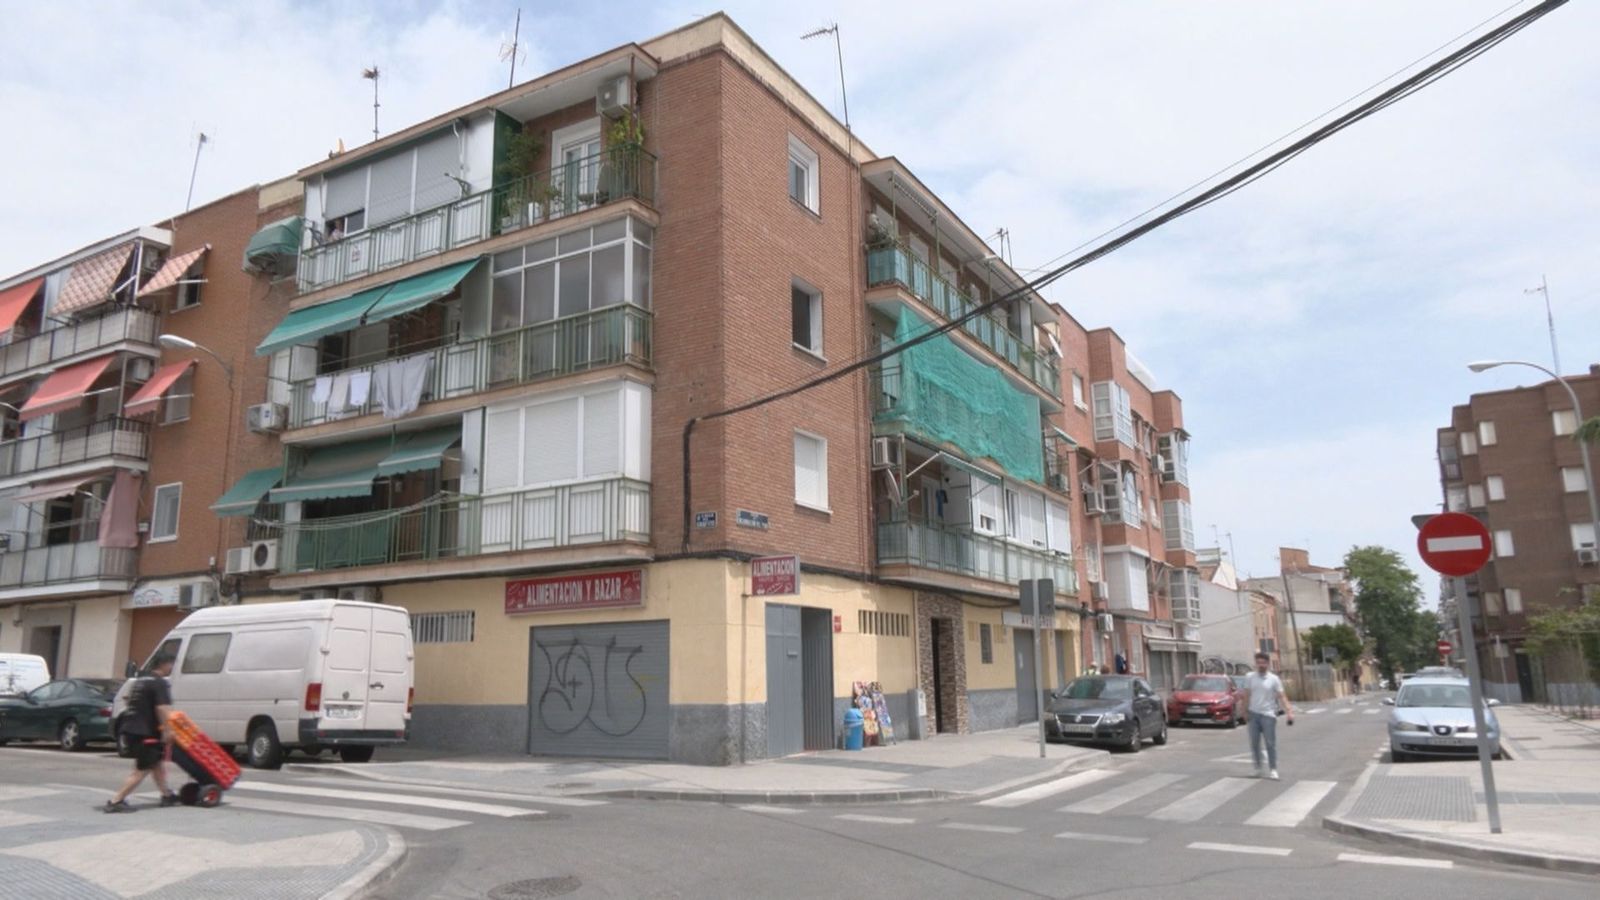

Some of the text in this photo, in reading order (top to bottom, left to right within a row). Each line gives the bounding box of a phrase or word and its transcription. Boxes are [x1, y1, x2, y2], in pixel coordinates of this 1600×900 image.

[753, 560, 795, 576] ALIMENTACION
[527, 577, 621, 605] ALIMENTACION Y BAZAR
